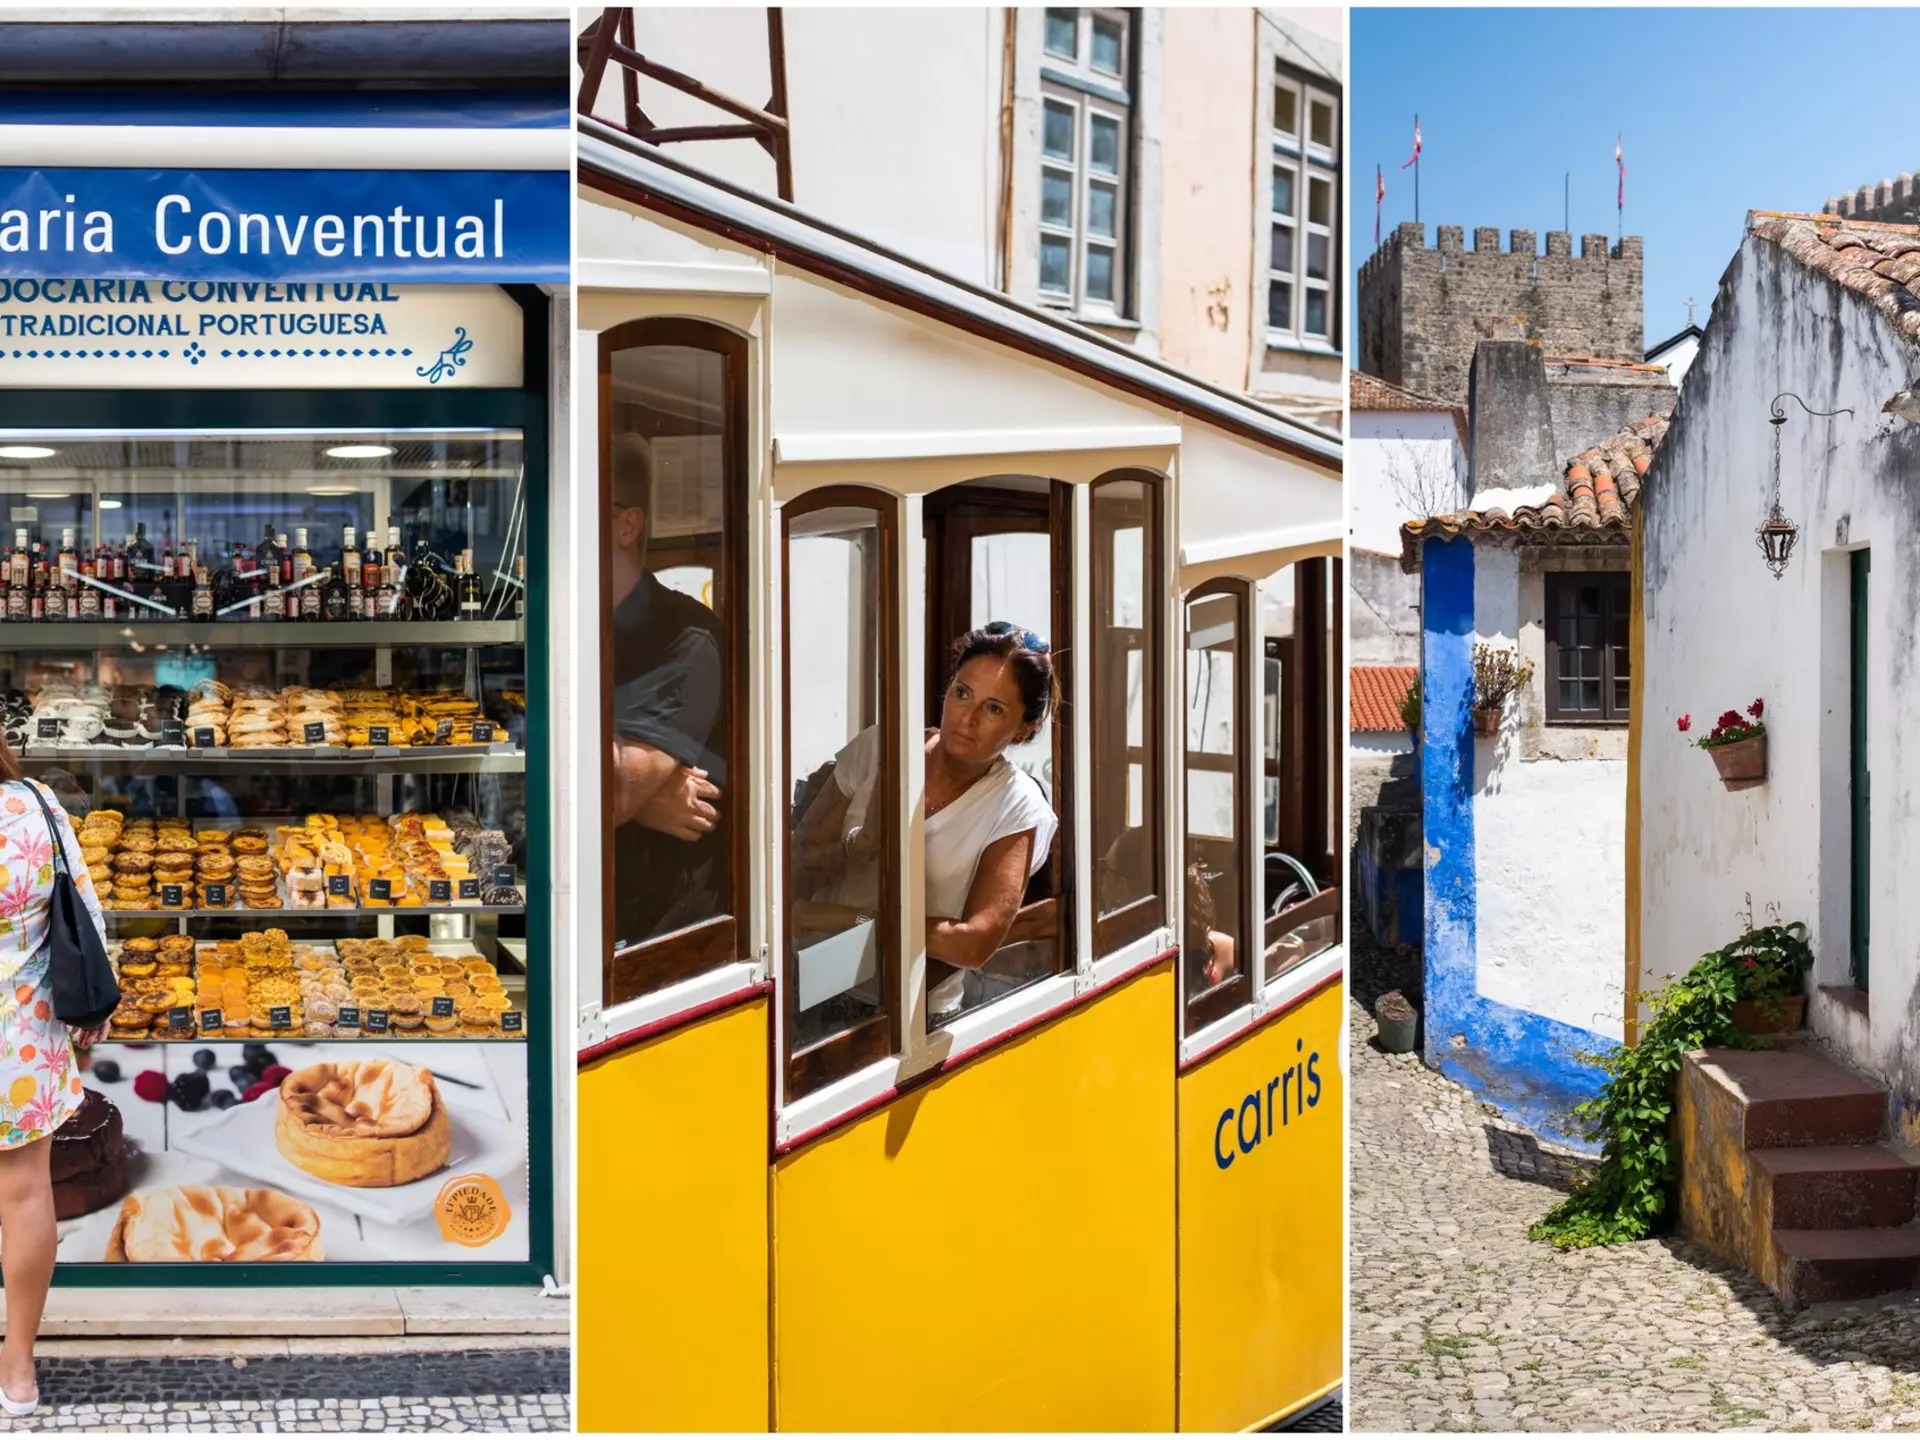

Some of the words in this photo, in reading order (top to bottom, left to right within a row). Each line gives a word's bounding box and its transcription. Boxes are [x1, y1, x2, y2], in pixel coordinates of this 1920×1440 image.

[155, 193, 504, 258] Conventual
[162, 280, 400, 303] CONVENTUAL
[1, 314, 190, 337] TRADICIONAL
[198, 313, 388, 337] PORTUGUESA
[1215, 1037, 1322, 1170] carris
